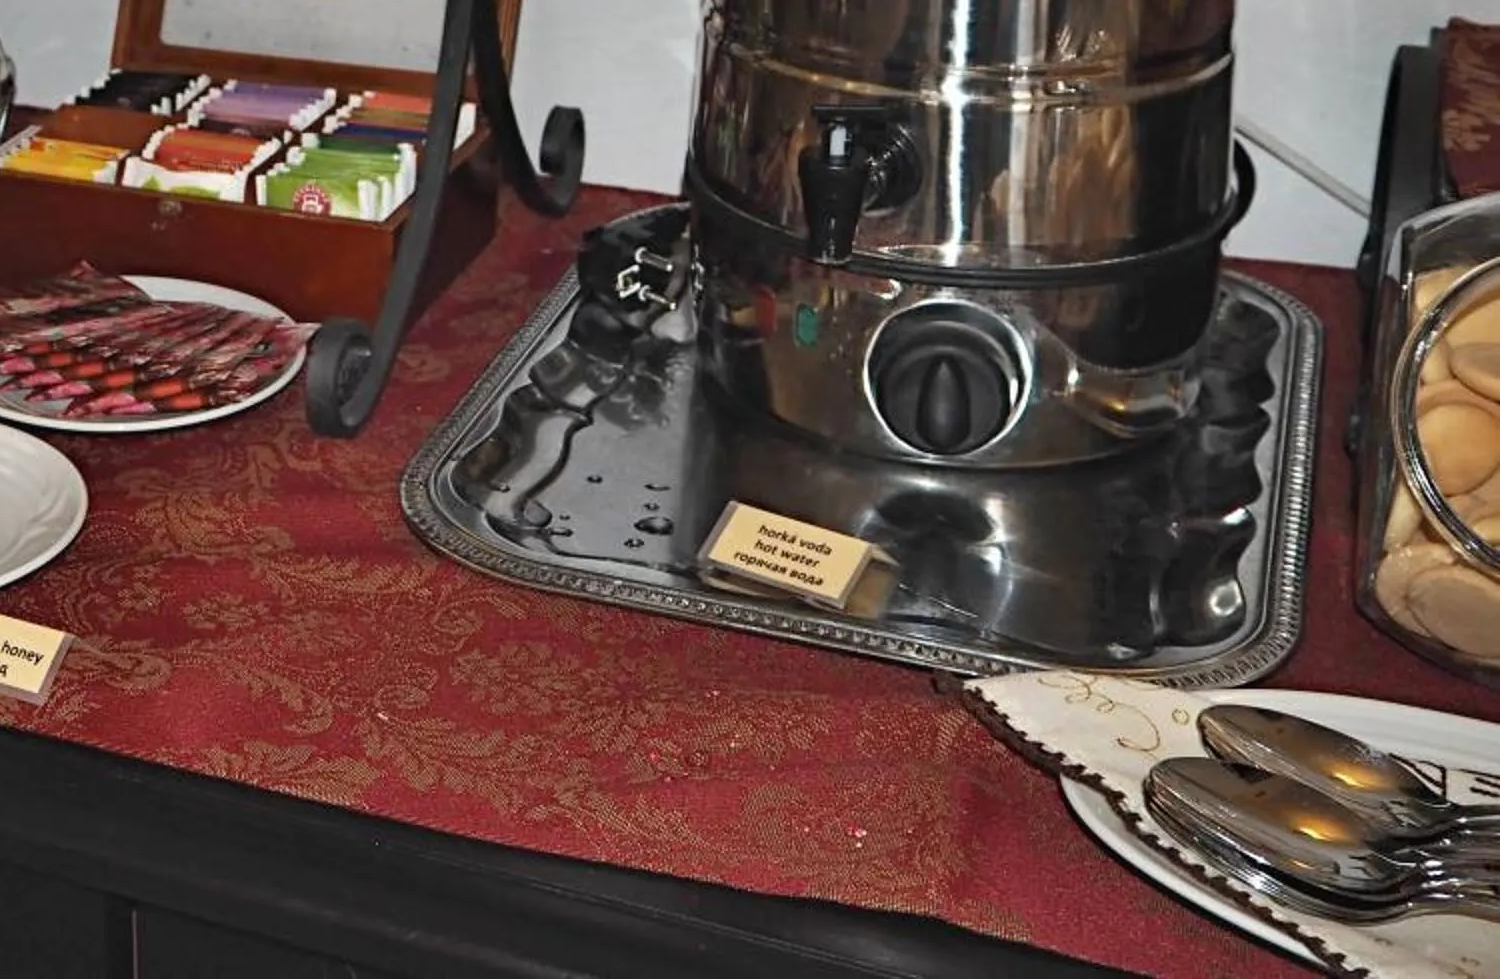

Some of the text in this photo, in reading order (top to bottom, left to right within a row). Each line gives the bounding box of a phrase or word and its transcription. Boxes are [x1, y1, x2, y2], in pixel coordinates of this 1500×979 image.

[754, 539, 820, 568] hot water
[757, 525, 833, 556] horká voda
[734, 551, 824, 586] горячая вода
[1, 641, 44, 666] honey
